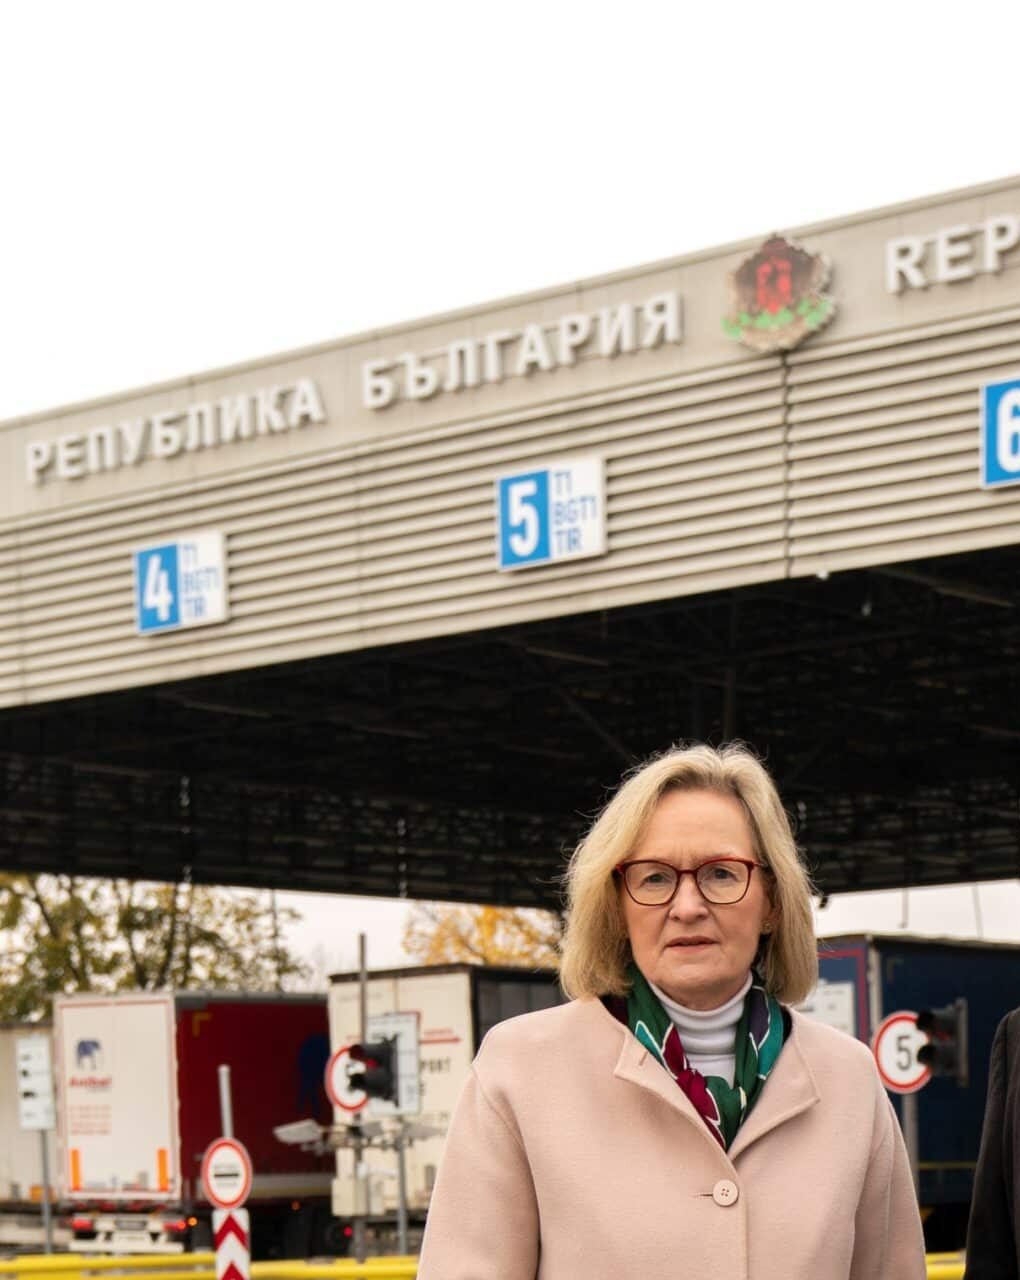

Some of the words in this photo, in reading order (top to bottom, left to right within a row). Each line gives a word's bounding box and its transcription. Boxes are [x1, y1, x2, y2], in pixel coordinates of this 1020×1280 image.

[25, 376, 328, 484] РЕПУБЛИКА
[360, 289, 684, 411] БЪЛГАРИЯ
[507, 480, 540, 557] 5
[143, 553, 174, 622] 4
[895, 1034, 912, 1072] 5
